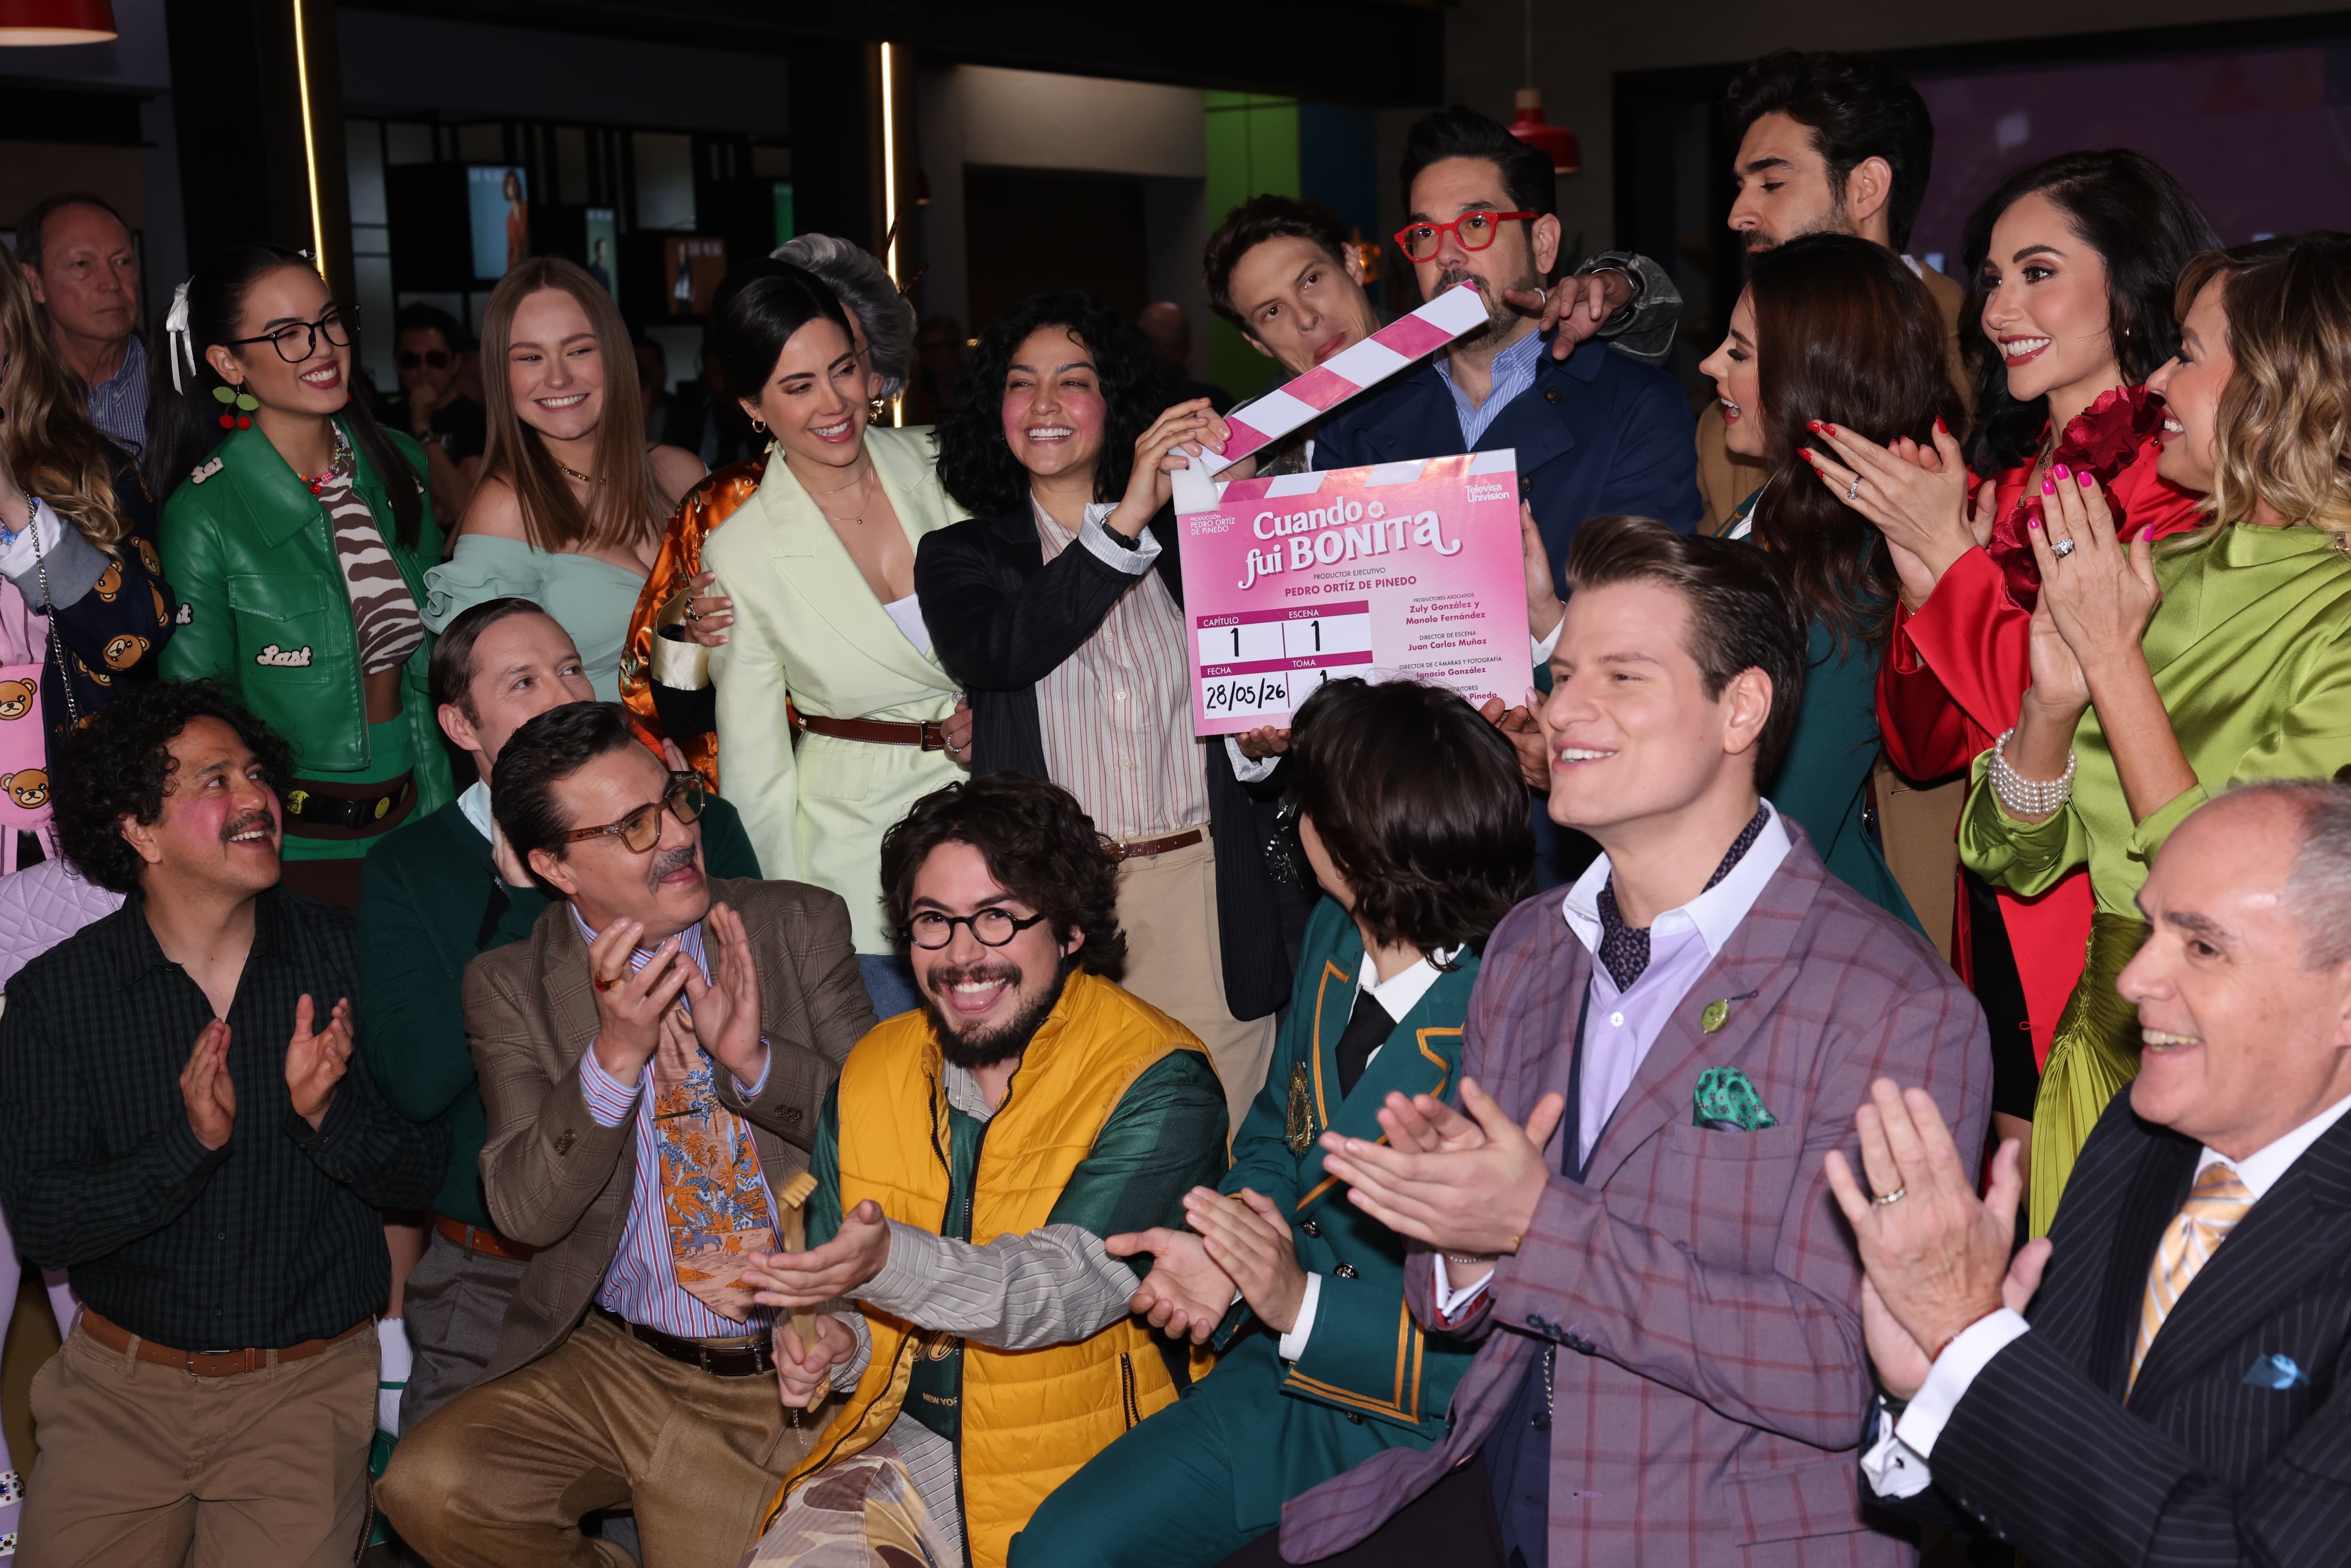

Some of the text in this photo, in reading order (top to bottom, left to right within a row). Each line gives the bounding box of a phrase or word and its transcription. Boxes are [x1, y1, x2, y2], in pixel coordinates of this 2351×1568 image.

[1464, 483, 1502, 494] Televisa
[1468, 491, 1510, 503] Univision
[1190, 514, 1221, 522] PRODUCCIÓN
[1190, 516, 1236, 529] PEDRO ORTÍZ
[1253, 495, 1364, 540] Cuando
[1202, 525, 1229, 534] PINEDO
[1237, 544, 1285, 590] fui
[1313, 567, 1386, 580] PRODUCTOR EJECUTIVO
[1285, 576, 1417, 597] PEDRO ORTÍZ DE PINEDO
[1409, 604, 1429, 614] Zuly
[1431, 600, 1472, 611] González
[1203, 609, 1320, 627] CAPÍTULO ESCENA
[1406, 611, 1486, 625] Manolo Fernández
[1230, 627, 1239, 657] 1
[1311, 620, 1320, 651] 1
[1430, 640, 1456, 649] Carlos
[1458, 638, 1487, 646] Muñoz
[257, 645, 311, 667] Last
[1467, 655, 1502, 665] FOTOGRAFÍA
[1207, 659, 1316, 676] FECHA TOMA
[1417, 666, 1486, 680] Ignacio González
[1206, 677, 1286, 711] 28/05/26
[1469, 691, 1497, 700] Pinedo
[922, 1392, 957, 1407] NEW YO
